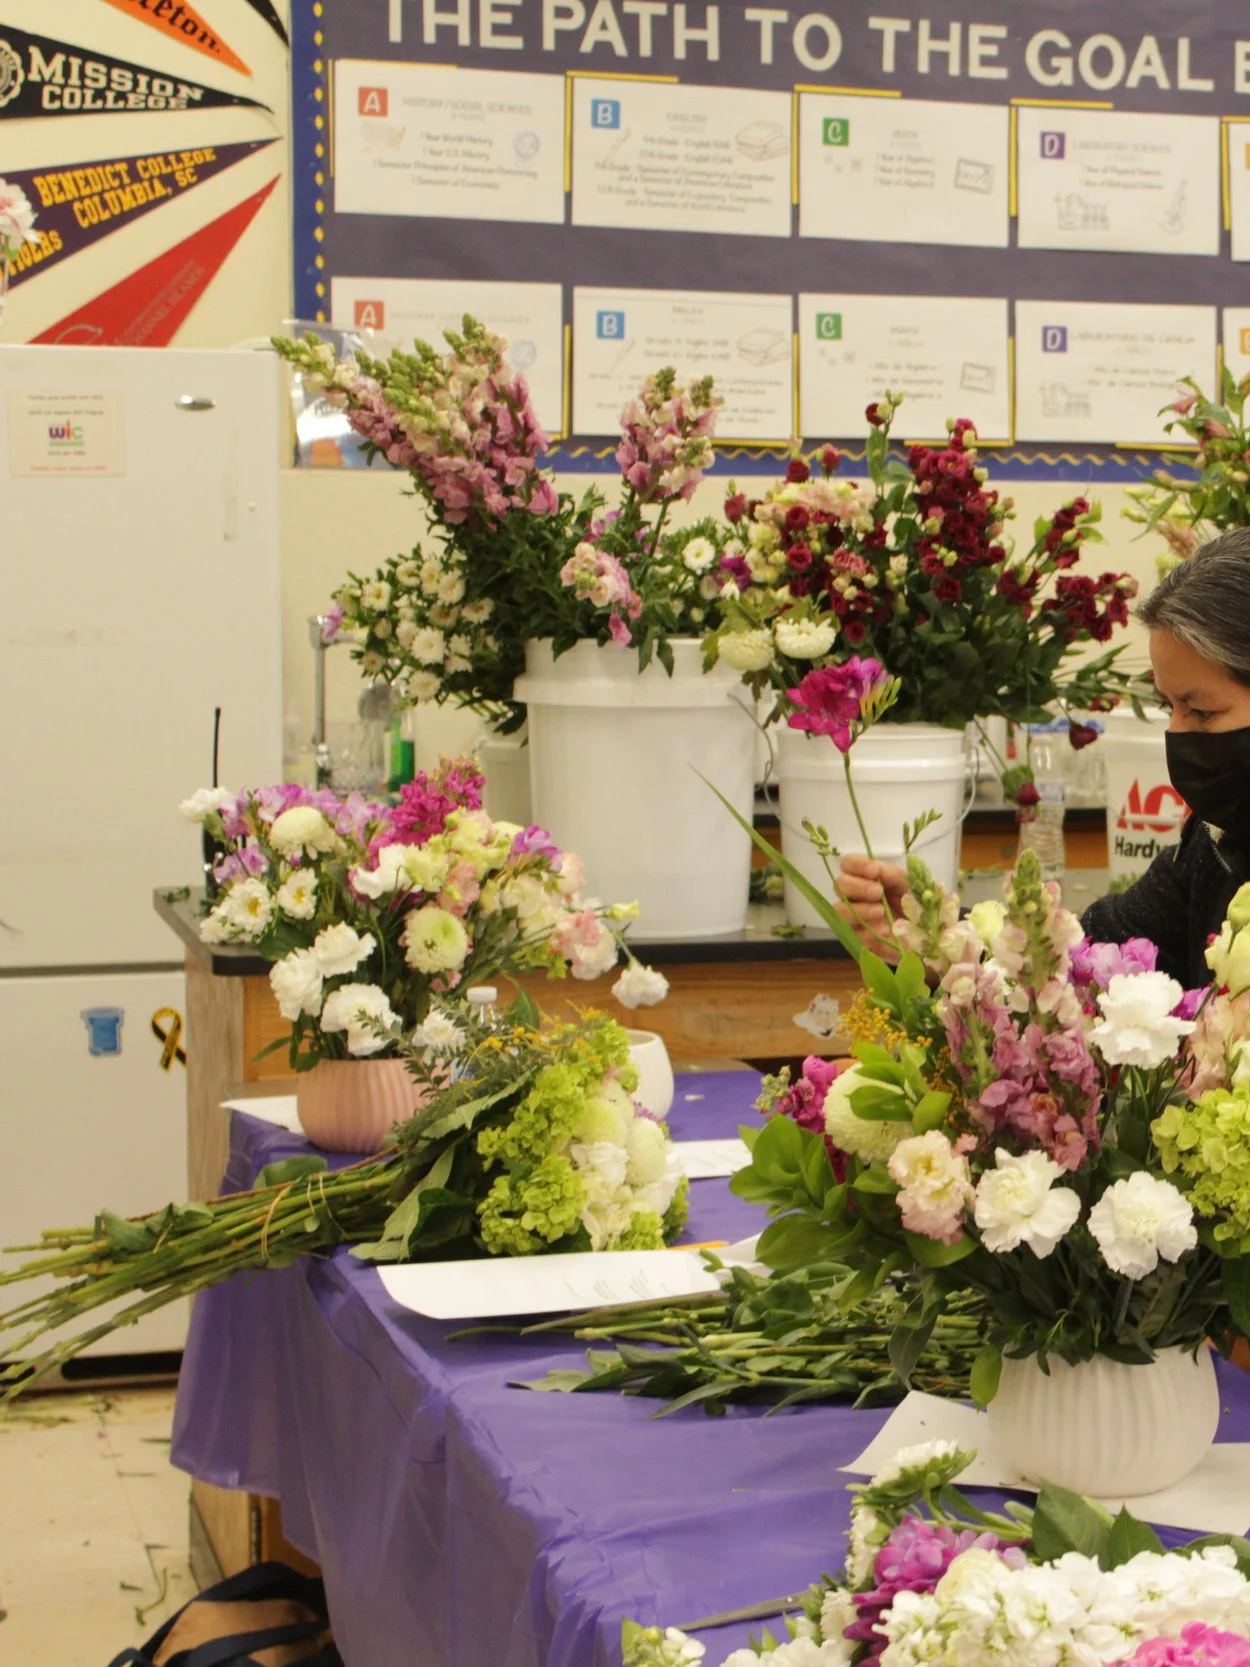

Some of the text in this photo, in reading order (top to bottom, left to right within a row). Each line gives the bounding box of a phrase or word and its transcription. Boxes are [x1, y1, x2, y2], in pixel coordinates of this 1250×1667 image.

[389, 0, 524, 49] THE
[542, 0, 720, 61] PATH
[745, 10, 843, 72] TO
[868, 17, 1009, 79] THE
[1024, 30, 1215, 91] GOAL
[27, 45, 204, 101] MISSION
[42, 84, 188, 110] COLLEGE
[363, 90, 382, 113] A
[597, 103, 613, 125] B
[827, 120, 842, 144] C
[1044, 133, 1060, 157] D
[33, 147, 217, 208] BENEDICT COLLEGE
[72, 168, 198, 228] COLUMBIA, SC
[360, 303, 377, 327] A
[602, 314, 618, 336] B
[820, 315, 836, 337] C
[1045, 328, 1062, 350] D
